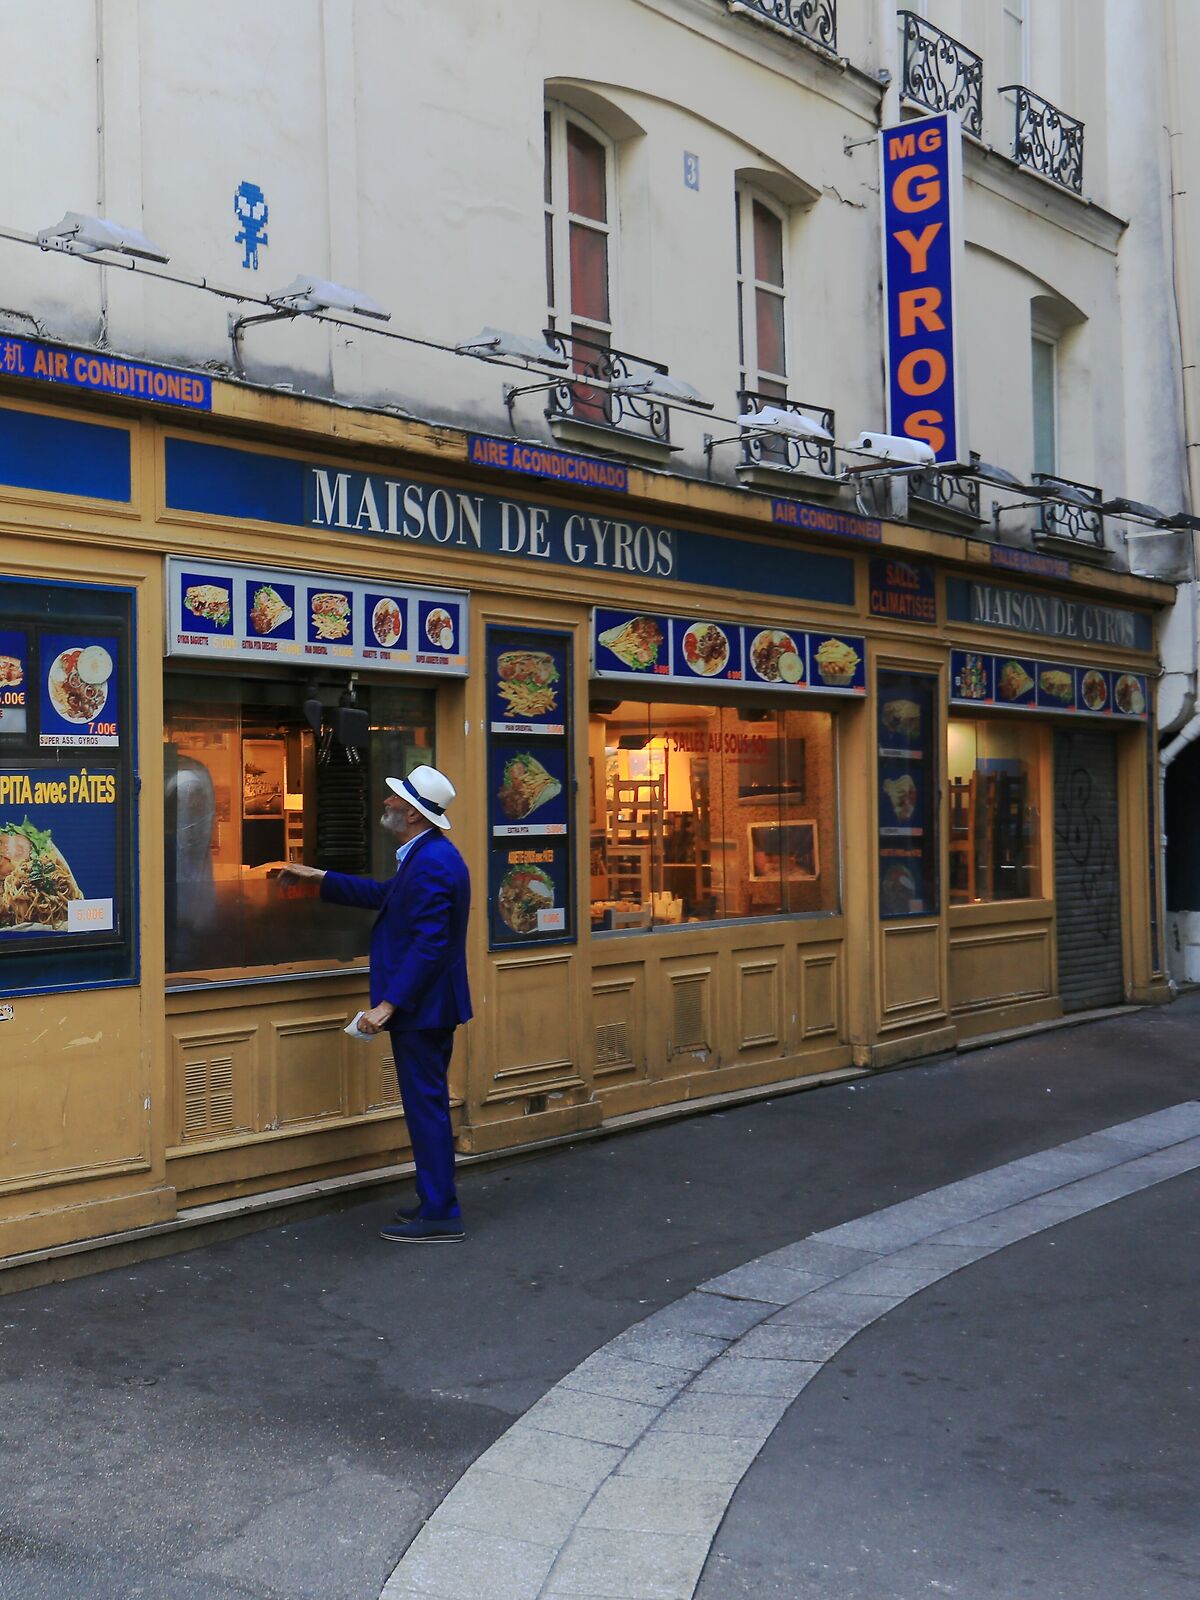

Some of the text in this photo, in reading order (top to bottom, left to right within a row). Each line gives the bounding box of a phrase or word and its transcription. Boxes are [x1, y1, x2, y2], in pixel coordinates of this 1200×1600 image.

[889, 127, 942, 160] MG
[687, 157, 697, 185] 3
[891, 163, 947, 455] GYROS
[33, 349, 205, 403] AIR CONDITIONED
[473, 439, 625, 488] AIRE ACONDICIONADO
[311, 469, 674, 577] MAISON DE GYROS
[775, 503, 881, 539] AIR CONDITIONED
[974, 585, 1134, 648] MAISON DE GYROS
[40, 736, 98, 745] SUPER ASS. GYROS
[88, 722, 117, 735] 7.00€
[0, 775, 33, 805] PITA
[34, 780, 67, 804] avec
[69, 768, 116, 804] PÂTES
